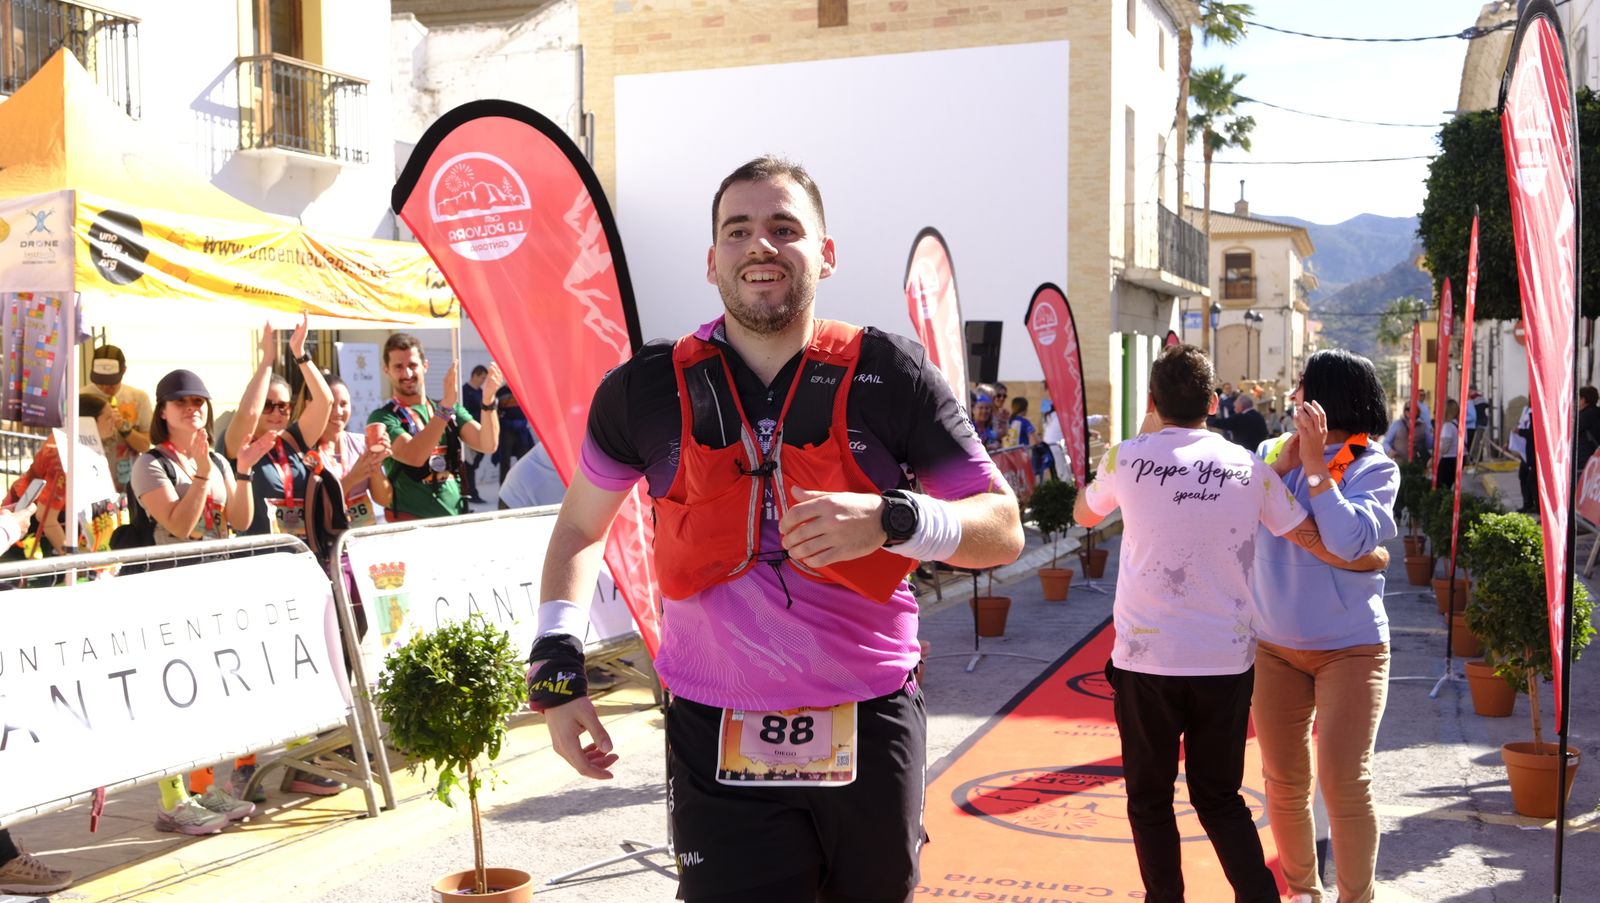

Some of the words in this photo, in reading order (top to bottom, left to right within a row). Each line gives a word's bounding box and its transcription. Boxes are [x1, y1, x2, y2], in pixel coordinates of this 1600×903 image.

[20, 240, 58, 248] DRONE
[99, 232, 118, 243] uno
[1131, 458, 1190, 486] Pepe
[1193, 460, 1252, 488] Yepes
[1173, 488, 1221, 504] speaker
[0, 608, 250, 676] NTAMIENTO
[265, 599, 300, 625] DE
[760, 715, 814, 745] 88
[680, 851, 704, 867] TRAIL
[943, 873, 1114, 898] Cantoria
